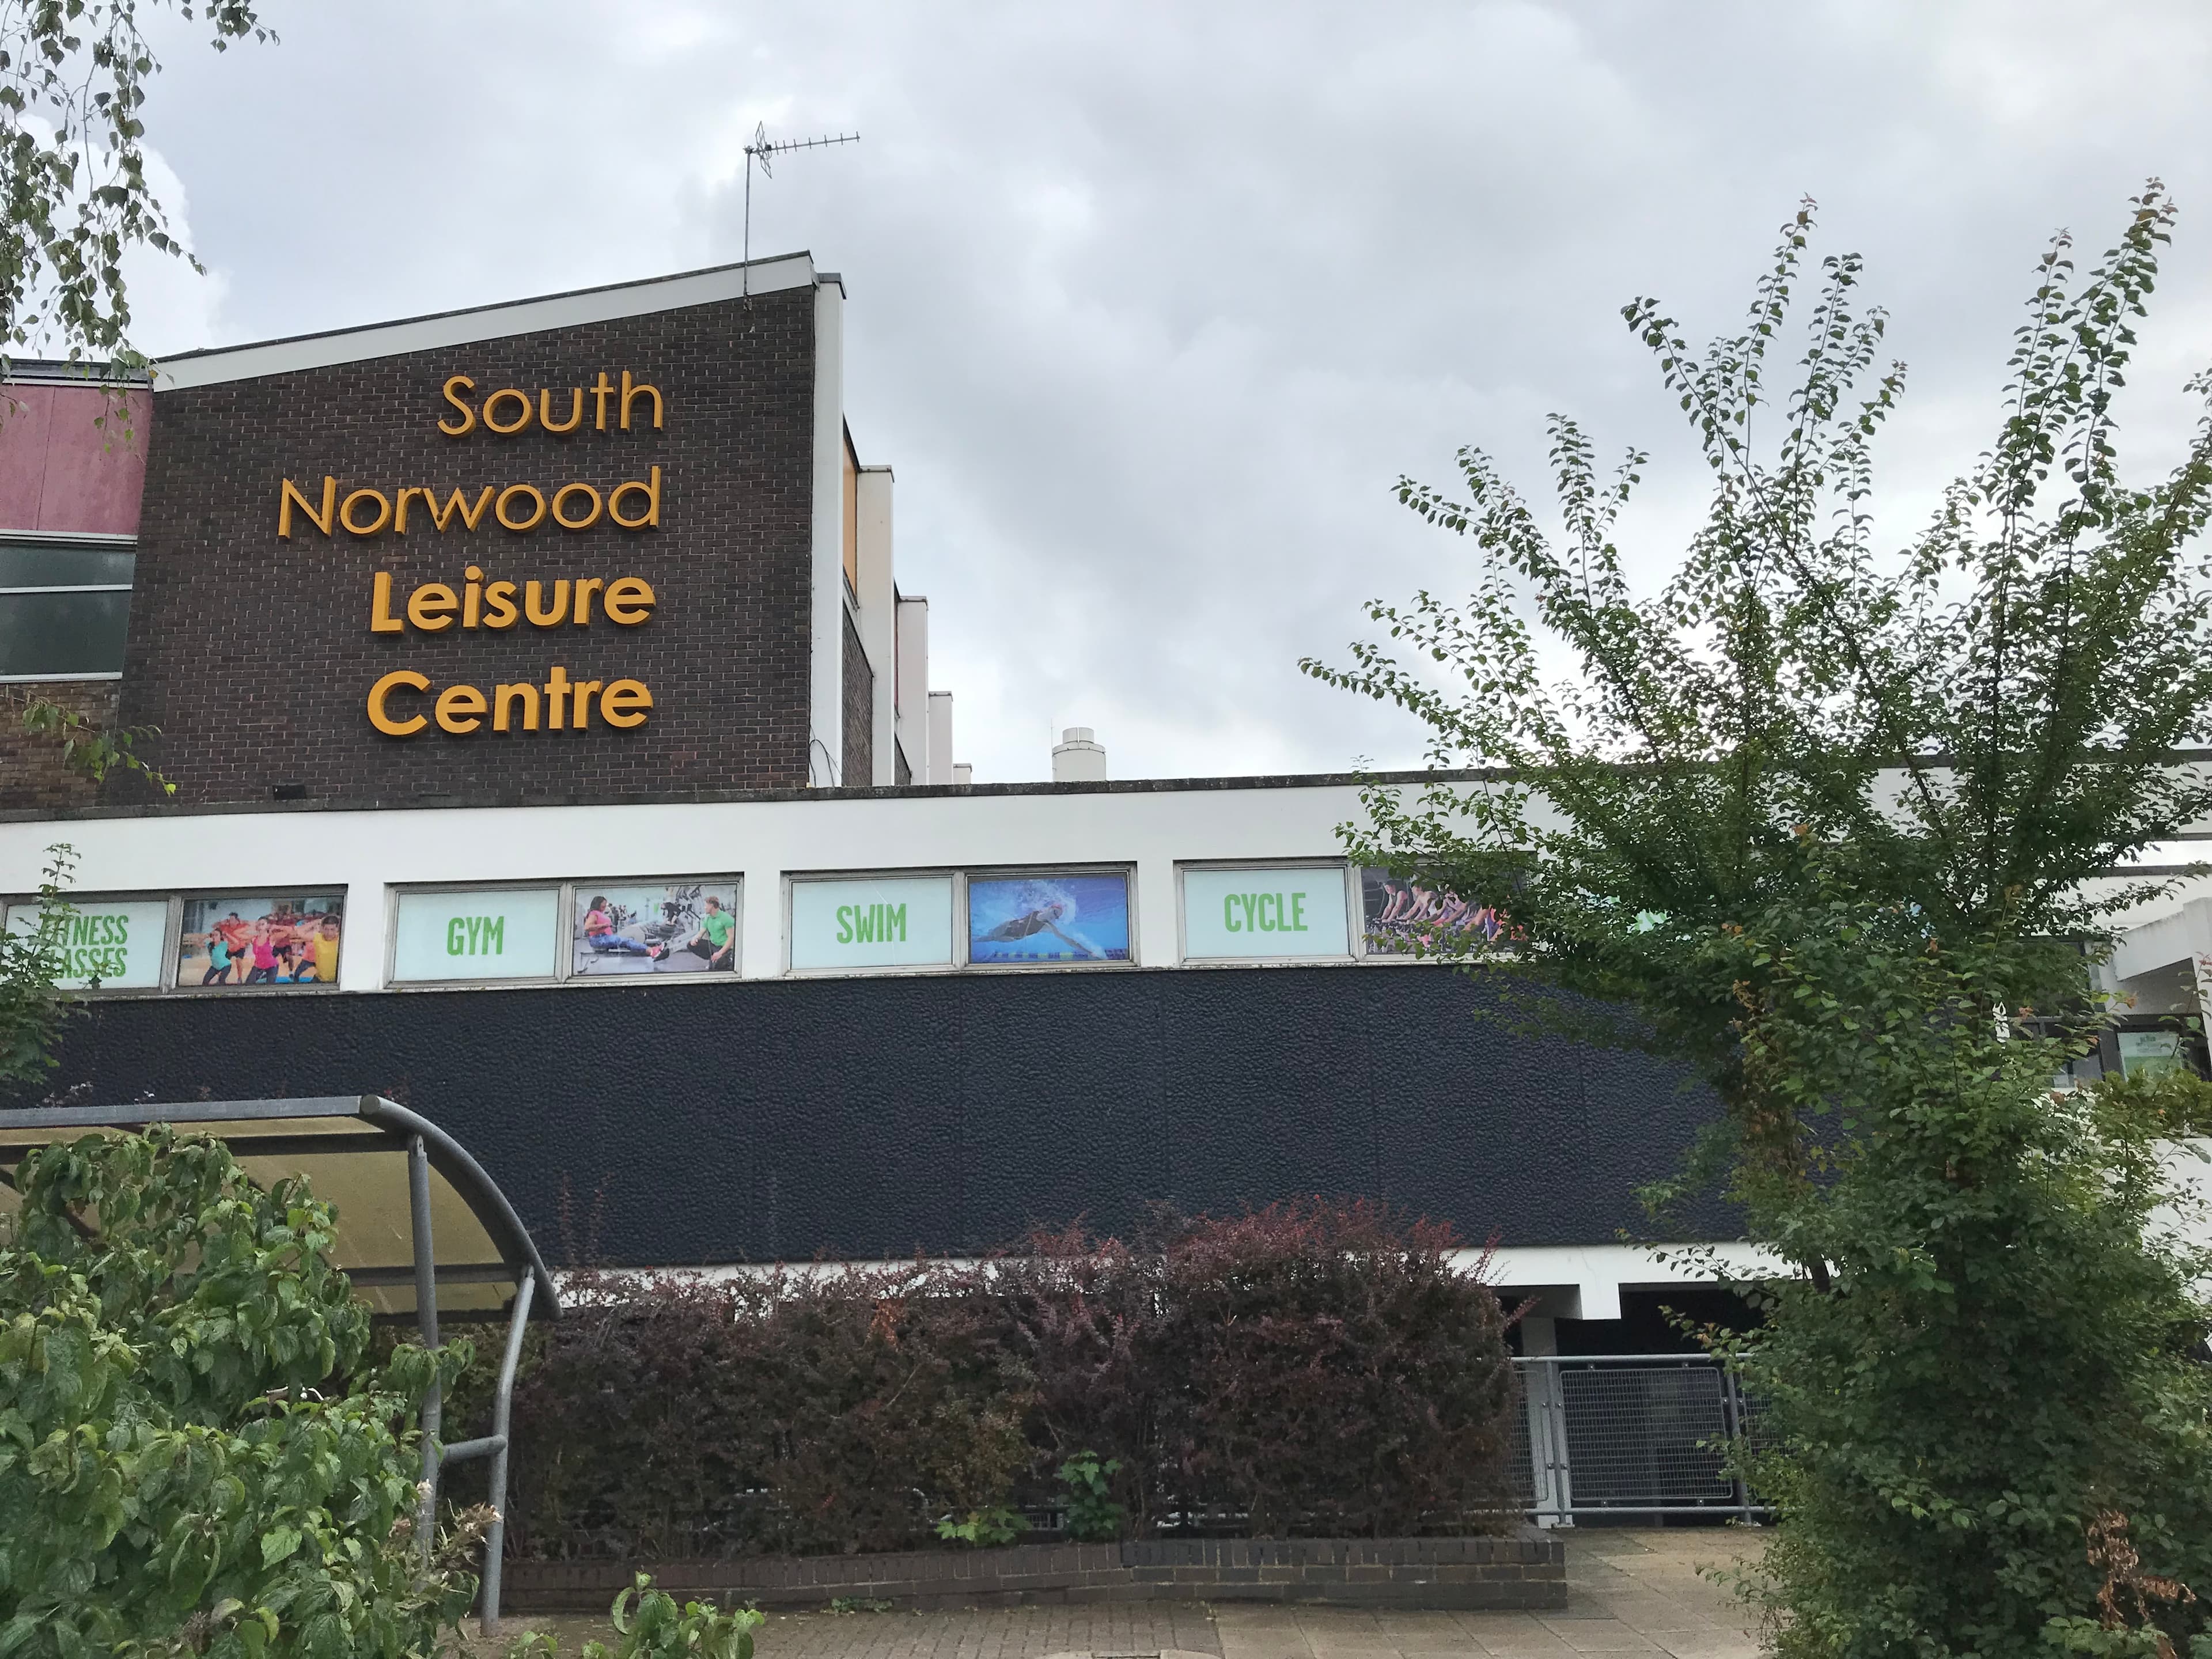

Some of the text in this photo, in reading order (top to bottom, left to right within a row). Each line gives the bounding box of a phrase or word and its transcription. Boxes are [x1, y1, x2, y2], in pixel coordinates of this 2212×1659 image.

[437, 370, 664, 435] South
[278, 465, 661, 539] Norwood
[370, 565, 657, 633] Leisure
[366, 666, 654, 736] Centre
[446, 916, 505, 956] GYM
[836, 903, 907, 944] SWIM
[1224, 892, 1308, 933] CYCLE
